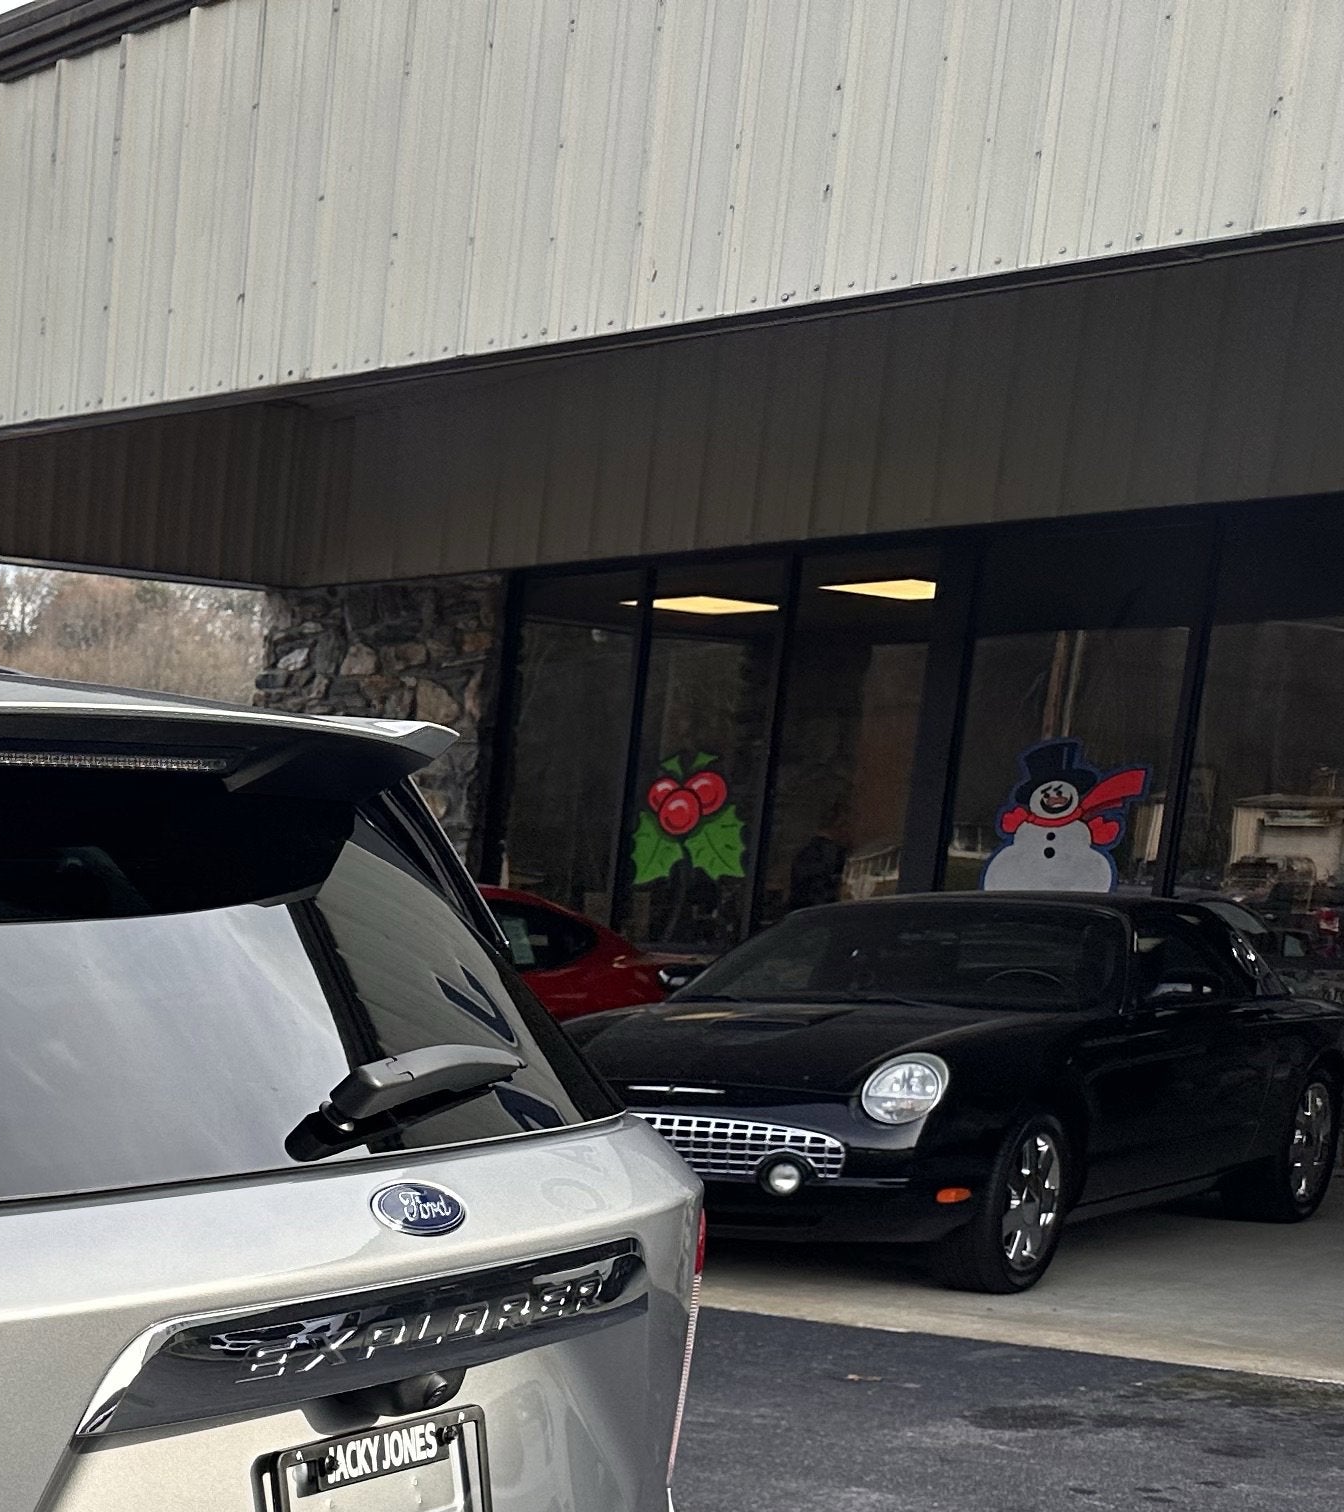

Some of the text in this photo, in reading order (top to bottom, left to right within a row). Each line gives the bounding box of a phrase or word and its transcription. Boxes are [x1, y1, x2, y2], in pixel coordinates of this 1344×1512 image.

[398, 1191, 452, 1221] Ford
[235, 1271, 603, 1384] EXPLORER
[328, 1422, 437, 1484] JACKY JONES
